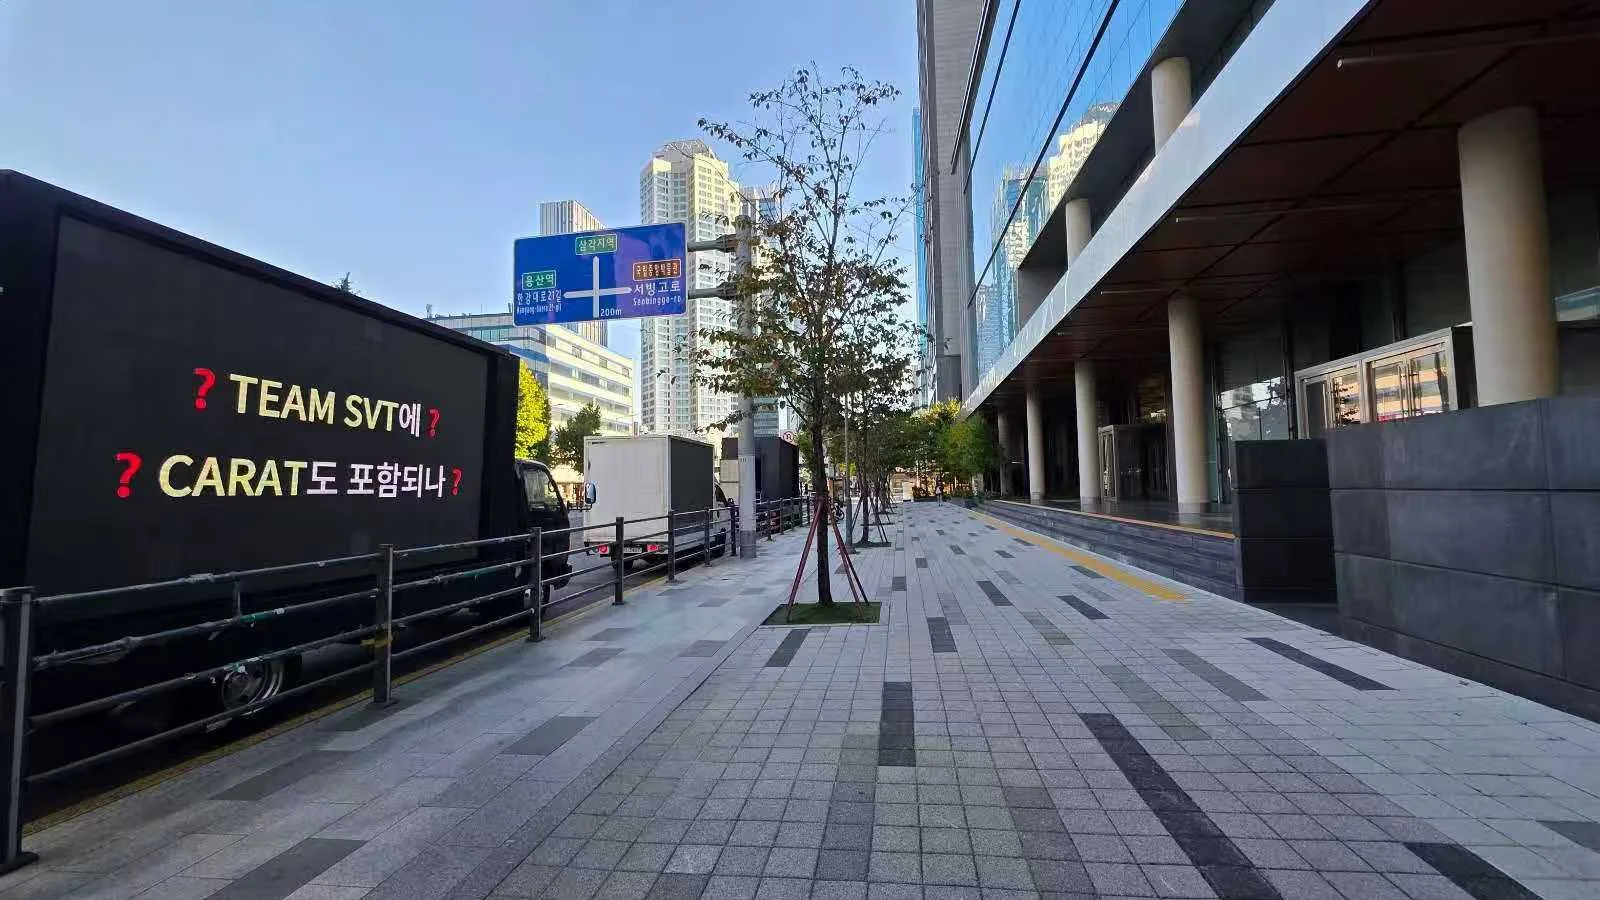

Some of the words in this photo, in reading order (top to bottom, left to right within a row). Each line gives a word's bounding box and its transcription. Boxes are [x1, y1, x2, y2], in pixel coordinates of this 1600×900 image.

[578, 237, 616, 252] 삼각지역
[525, 273, 554, 288] 용산역
[633, 280, 681, 296] 서빙고로
[600, 308, 622, 317] 200m
[229, 373, 336, 424] TEAM
[343, 394, 421, 438] SVT에
[158, 454, 338, 498] CARAT도
[346, 461, 447, 498] 포함되나
